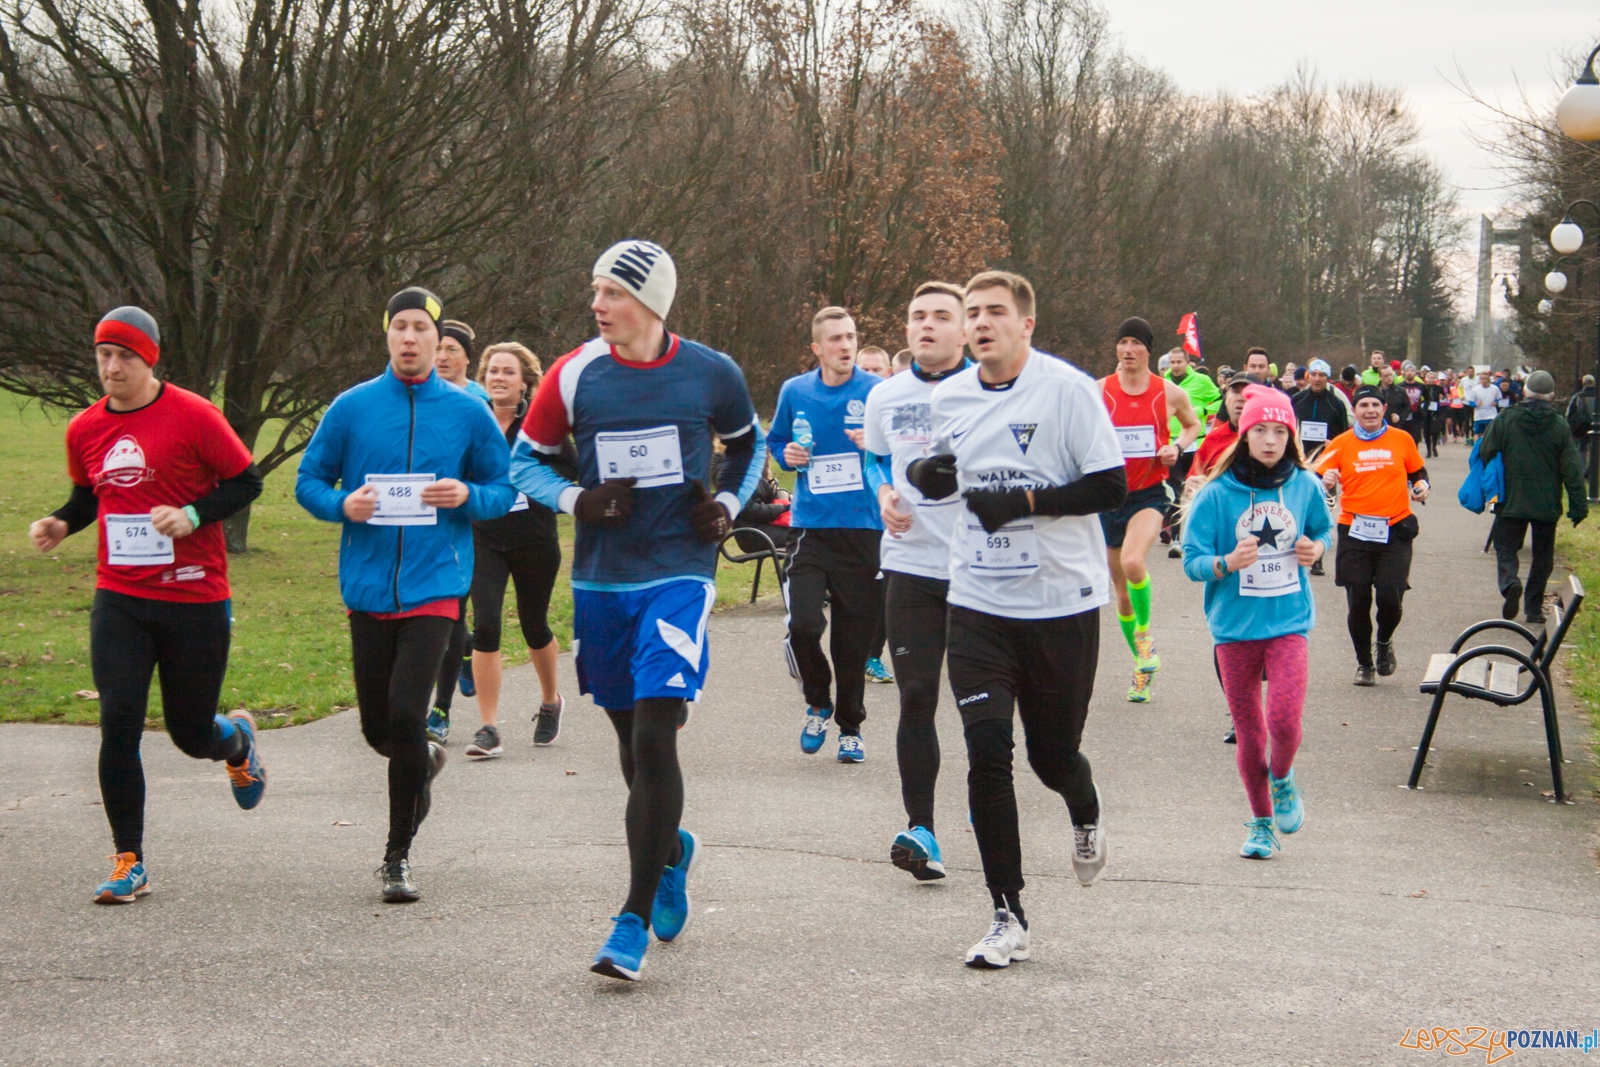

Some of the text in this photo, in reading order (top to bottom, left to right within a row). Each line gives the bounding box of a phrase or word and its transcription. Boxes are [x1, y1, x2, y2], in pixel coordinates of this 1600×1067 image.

[1261, 407, 1289, 423] NYC
[1124, 433, 1140, 442] 976
[629, 444, 648, 458] 60
[825, 463, 843, 473] 282
[976, 470, 1030, 483] WALKA
[388, 486, 412, 498] 488
[1363, 521, 1376, 529] 944
[126, 526, 148, 538] 674
[986, 536, 1011, 549] 693
[1260, 562, 1282, 573] 186
